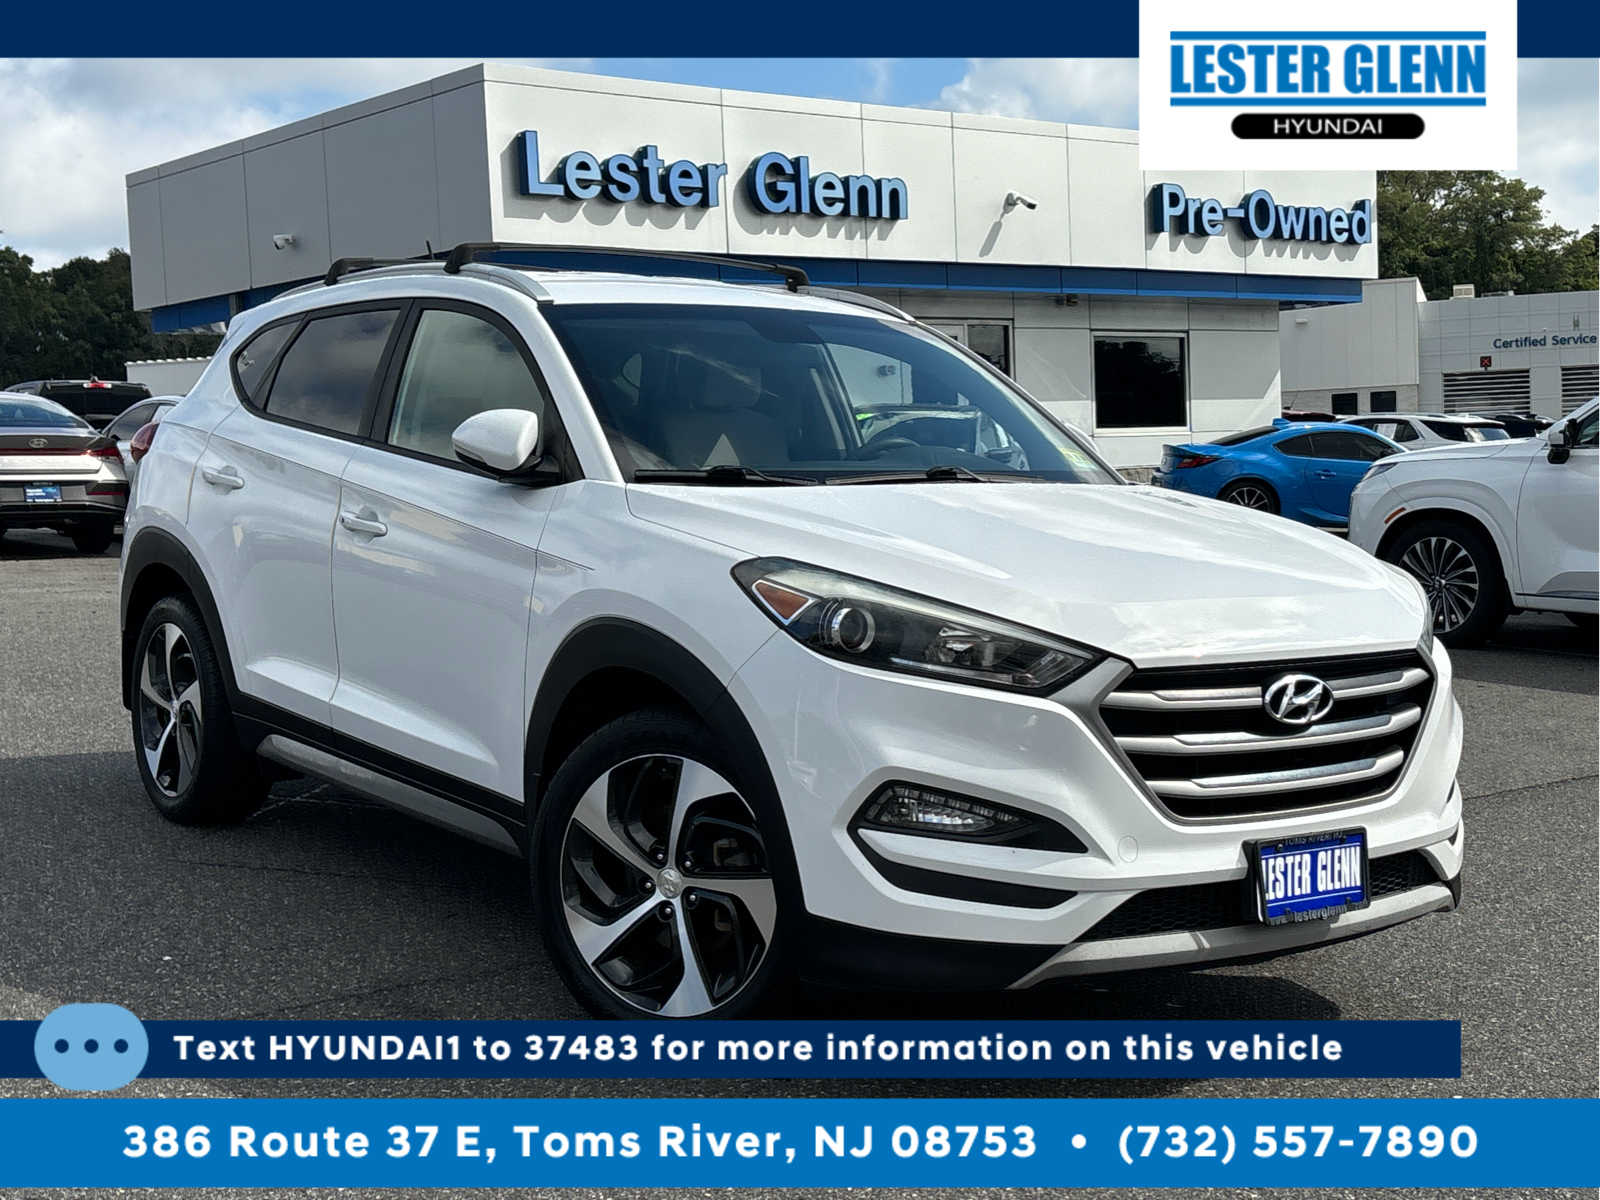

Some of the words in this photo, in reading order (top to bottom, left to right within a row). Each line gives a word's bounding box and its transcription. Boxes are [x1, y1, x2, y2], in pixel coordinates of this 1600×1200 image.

[520, 130, 727, 208] Lester
[748, 151, 908, 220] Glenn
[1151, 183, 1371, 244] Pre-Owned
[1493, 335, 1546, 349] Certified
[1551, 333, 1598, 346] Service
[1317, 846, 1362, 893] GLENN
